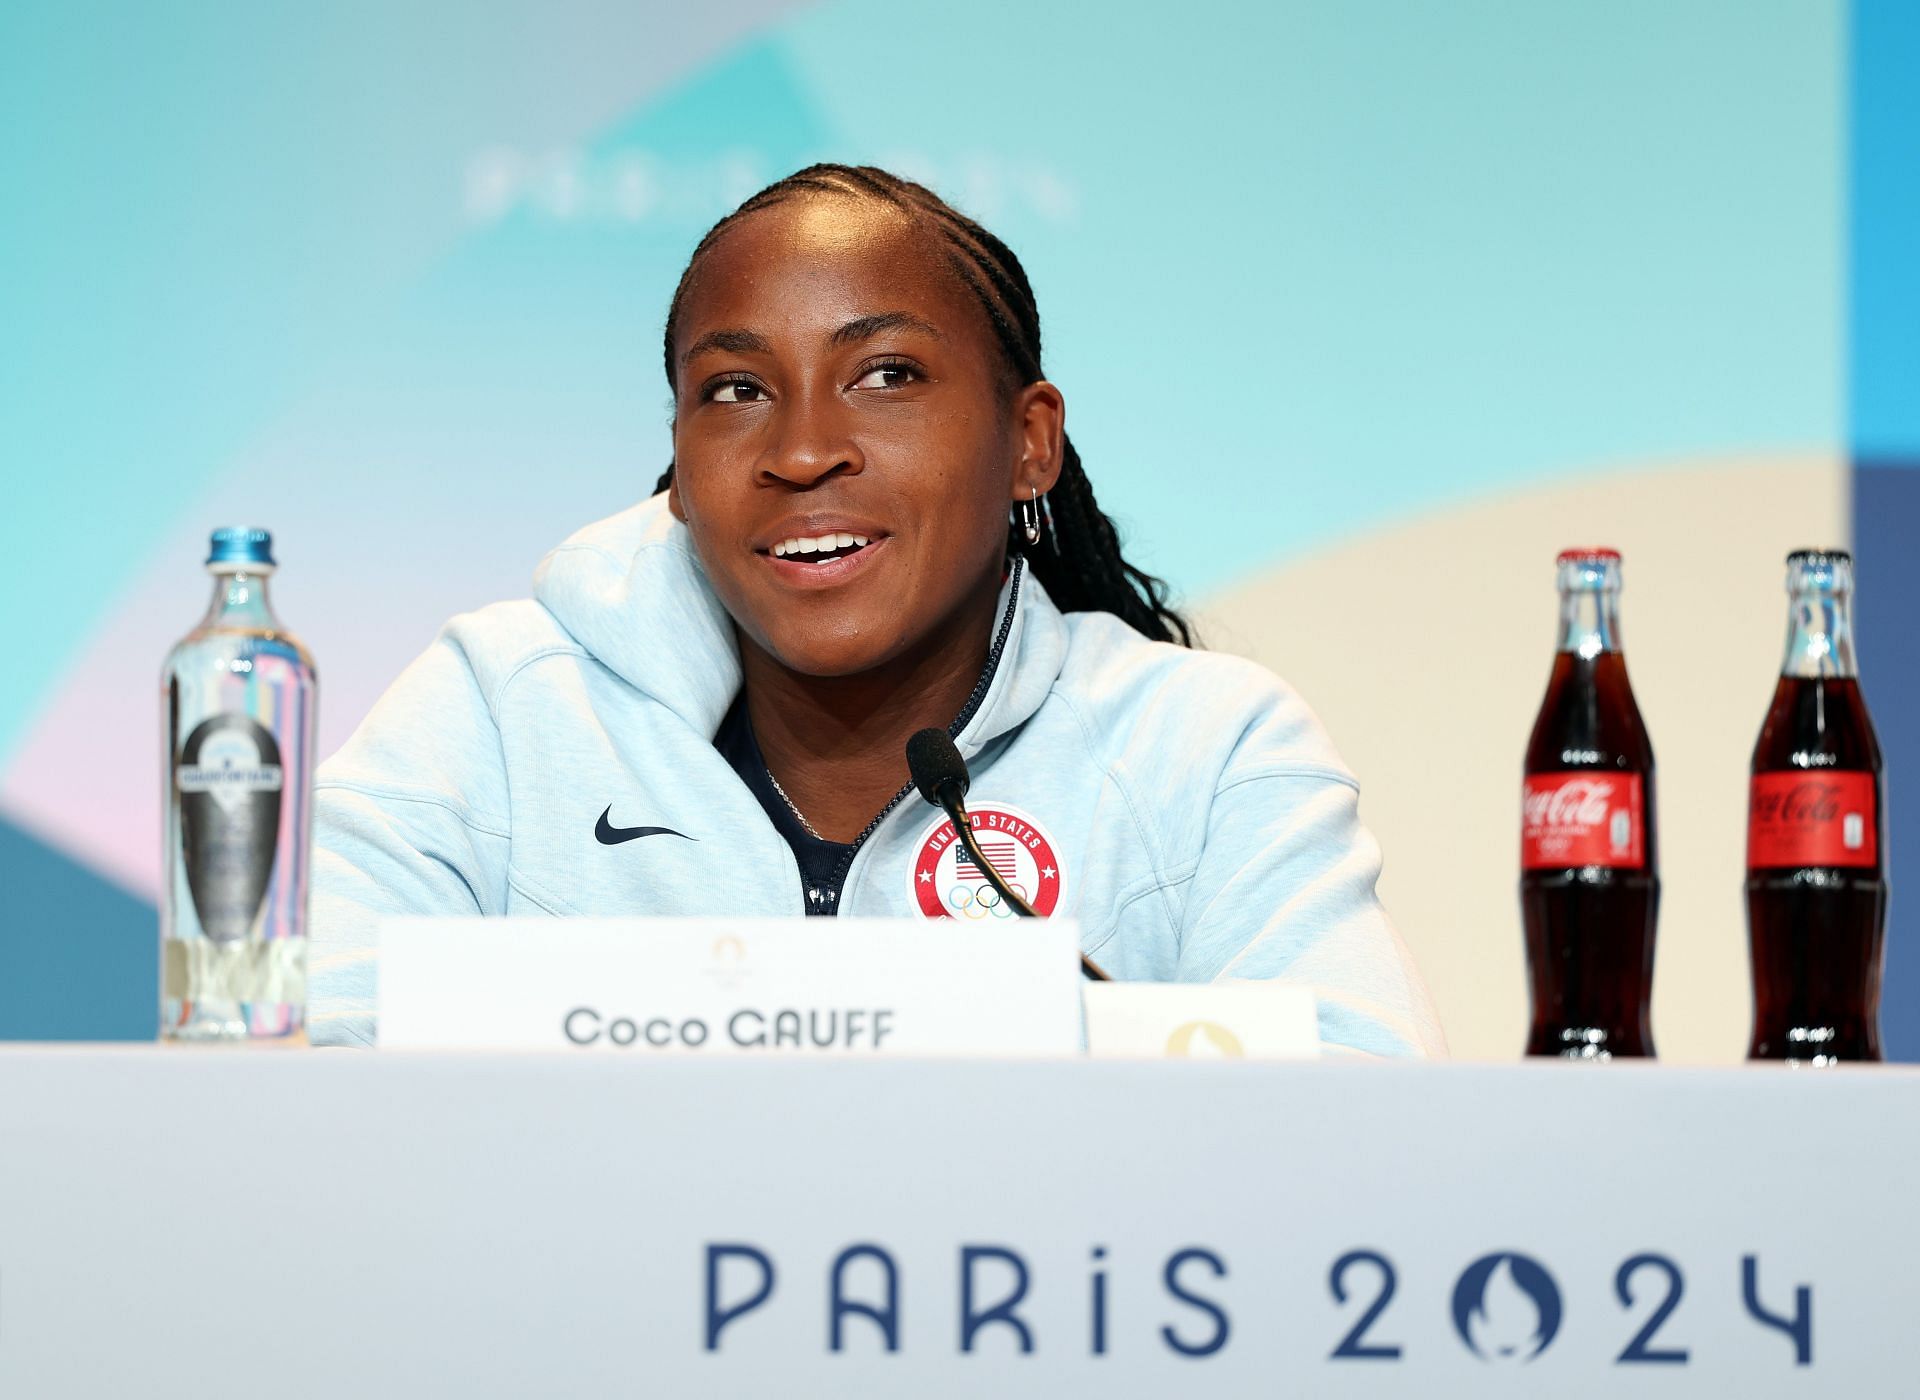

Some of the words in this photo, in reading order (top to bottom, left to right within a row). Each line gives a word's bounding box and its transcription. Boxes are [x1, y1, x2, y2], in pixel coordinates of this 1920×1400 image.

[929, 815, 981, 851] UNID
[989, 814, 1041, 849] STATES
[563, 1007, 708, 1047] Coco
[727, 1009, 894, 1048] GAUFF
[1327, 1248, 1814, 1367] 2024
